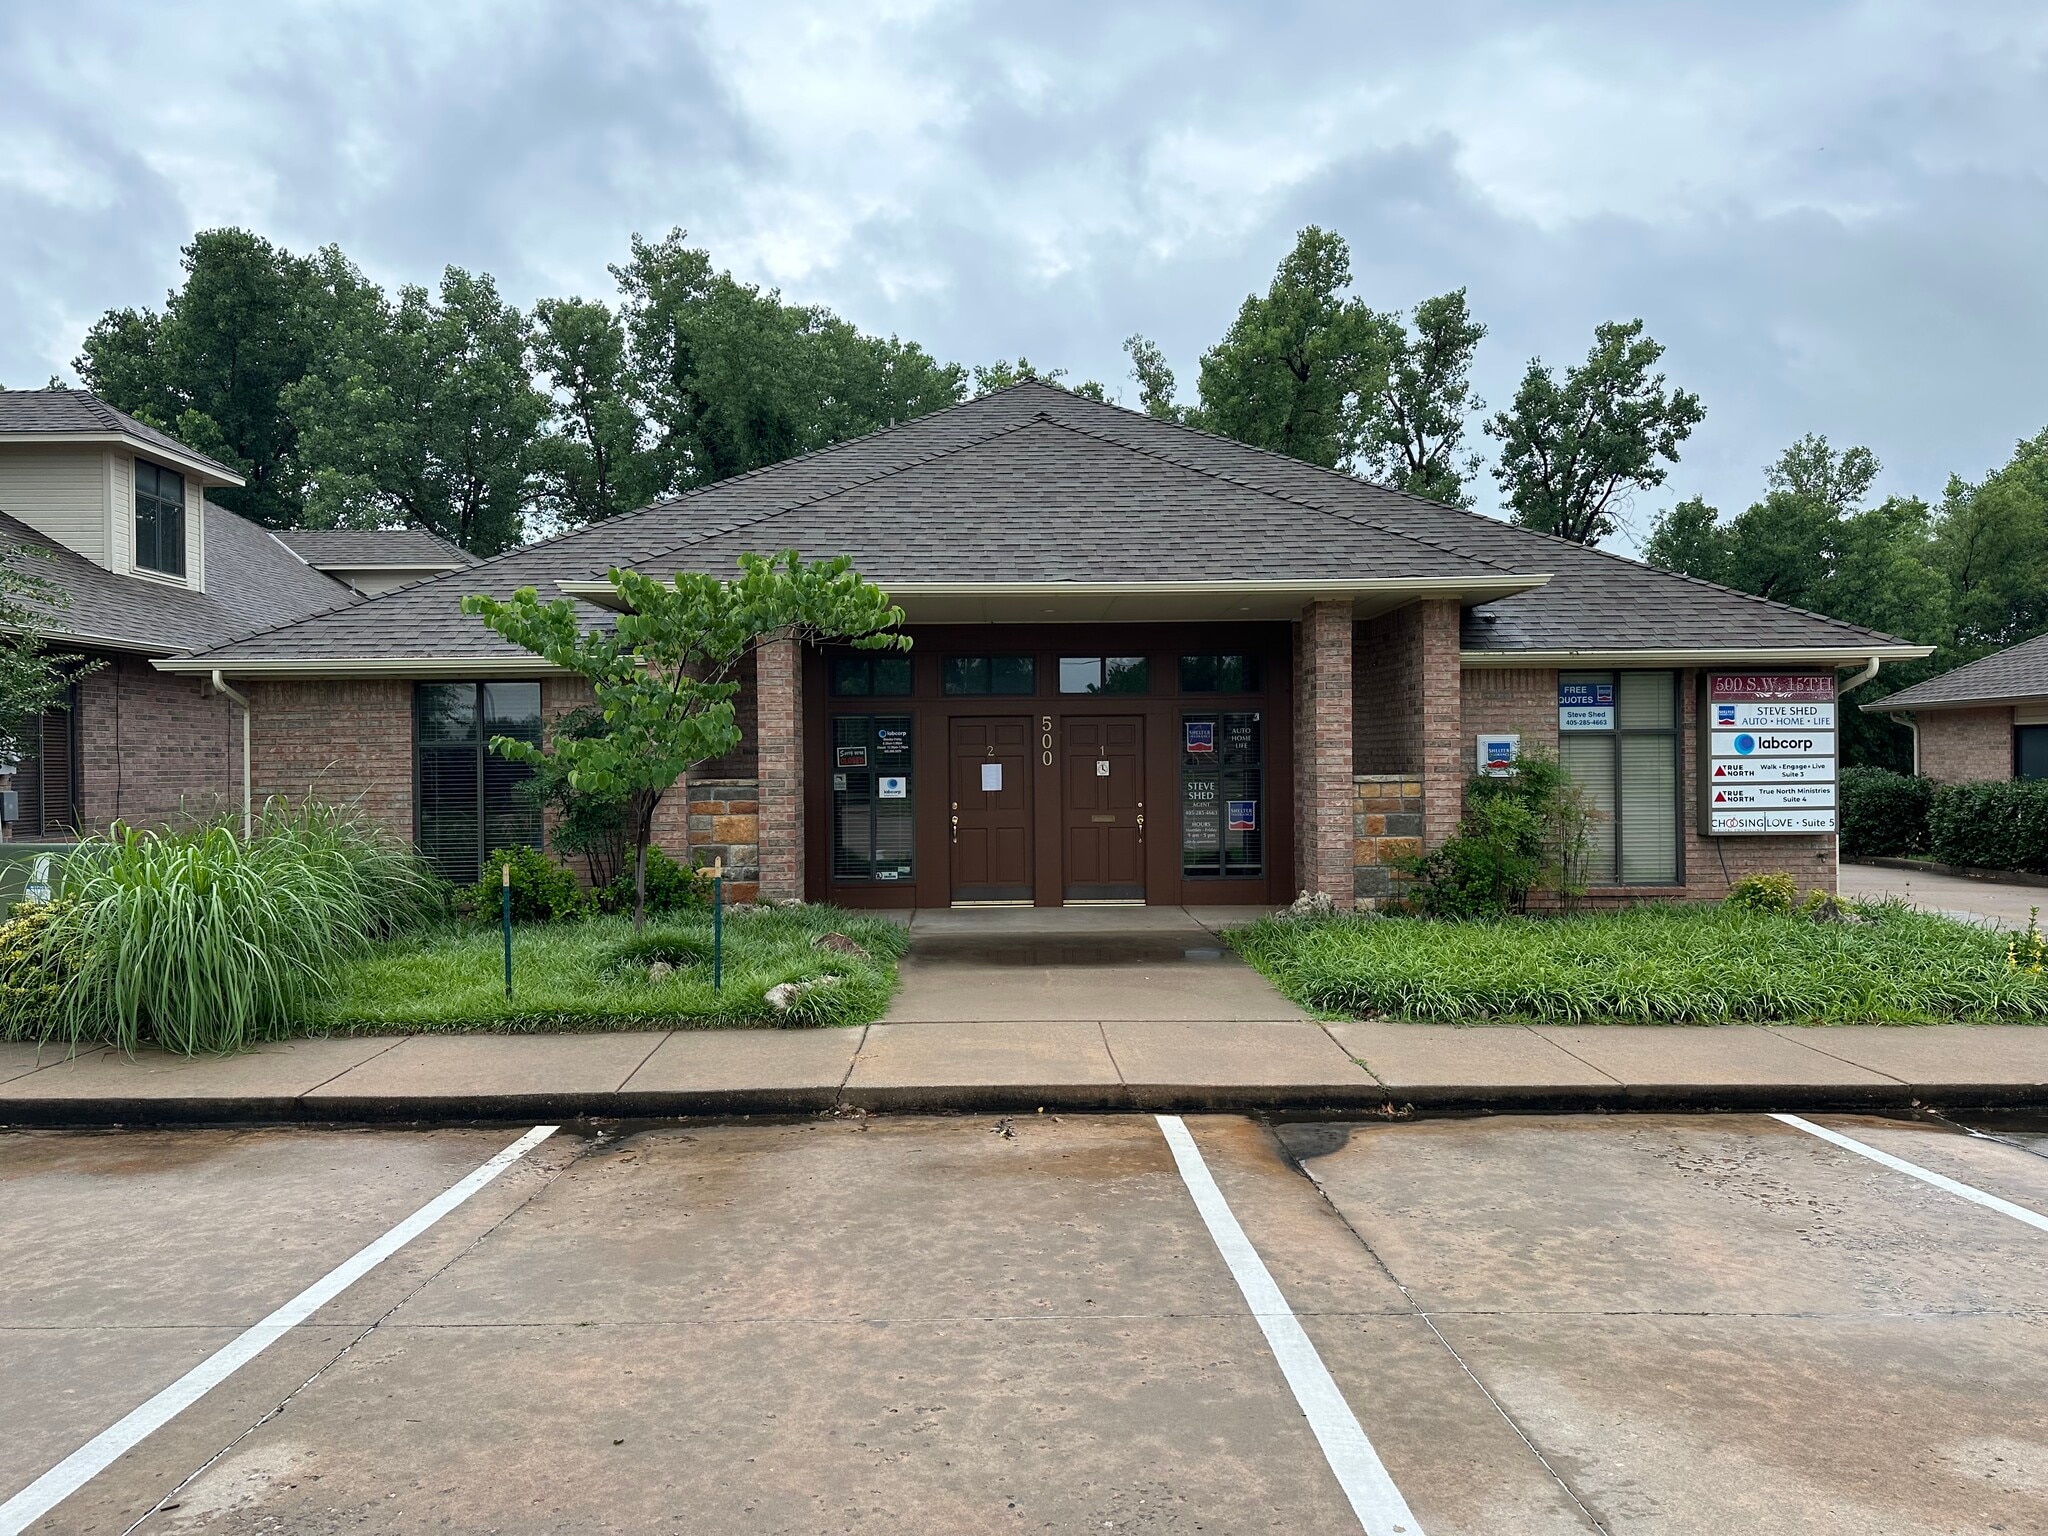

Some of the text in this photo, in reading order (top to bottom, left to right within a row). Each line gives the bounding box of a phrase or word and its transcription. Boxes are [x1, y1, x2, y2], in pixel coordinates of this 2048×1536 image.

[1716, 677, 1742, 692] 500
[1786, 677, 1833, 692] 15TH
[1564, 686, 1587, 694] FREE
[1559, 696, 1594, 704] QUOTES
[1757, 706, 1818, 715] STEVE SHED
[1741, 717, 1831, 725] AUTO HOME LIFE
[1042, 716, 1052, 766] 500
[1758, 736, 1813, 751] labcorp
[986, 746, 995, 757] 2
[1100, 746, 1105, 756] 1
[1187, 782, 1215, 791] STEVE
[1188, 791, 1215, 800] SHED
[1766, 819, 1793, 827] LOVE
[1802, 818, 1825, 827] Suite
[1829, 818, 1835, 827] 5
